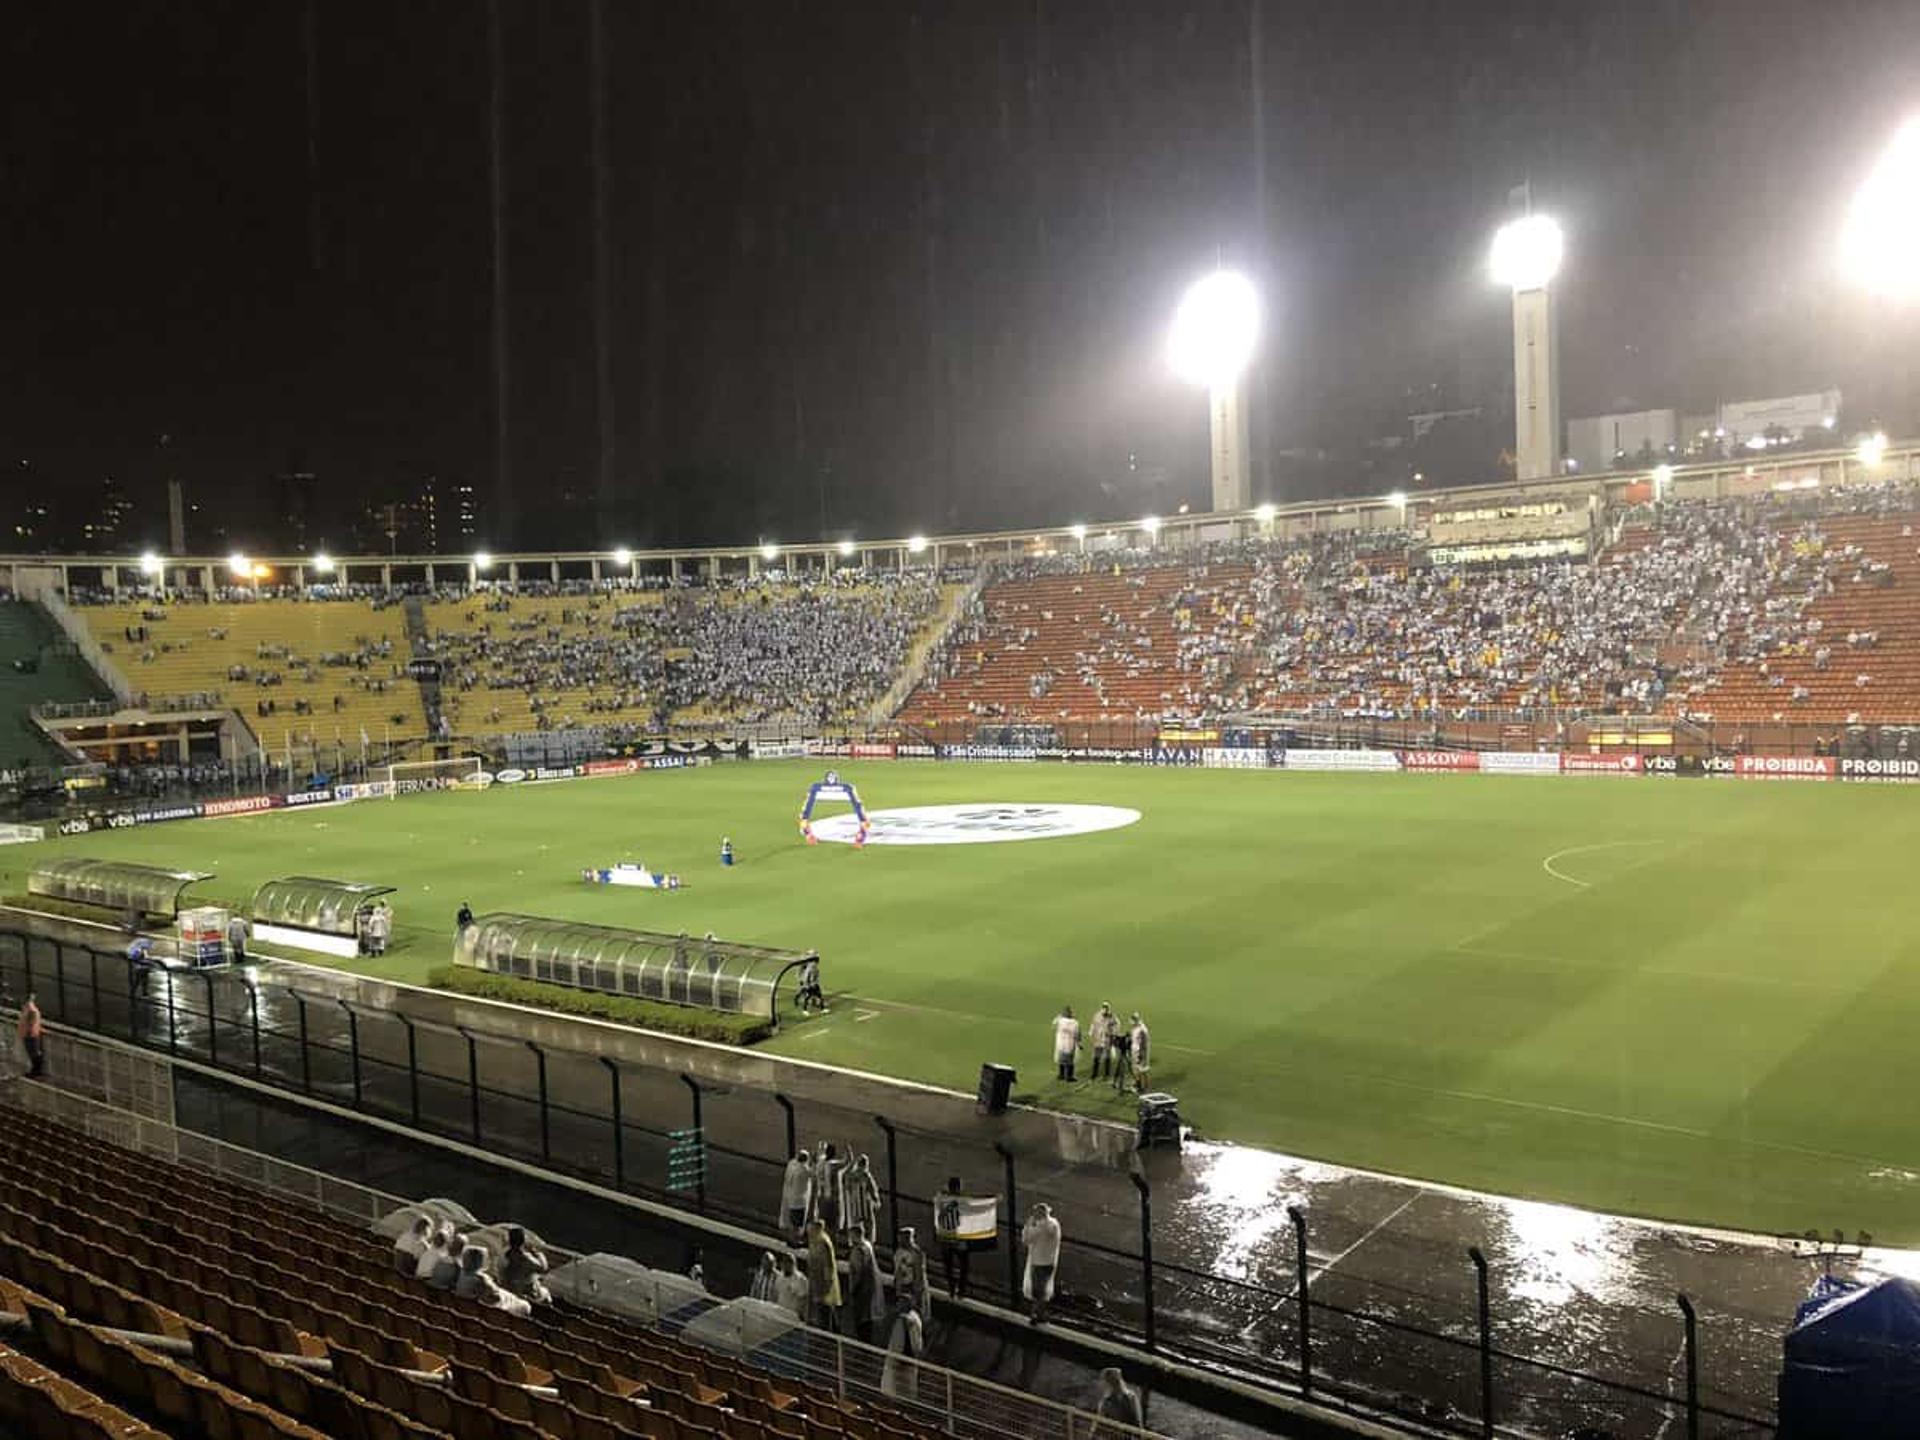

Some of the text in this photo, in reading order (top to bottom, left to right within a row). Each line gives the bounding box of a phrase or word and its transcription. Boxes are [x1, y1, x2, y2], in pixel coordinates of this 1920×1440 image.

[1143, 748, 1201, 760] HAVAN
[1207, 750, 1267, 762] HAVAN
[1407, 753, 1461, 765] ASKOV
[1644, 755, 1677, 770] vibe
[1702, 756, 1735, 770] vibe
